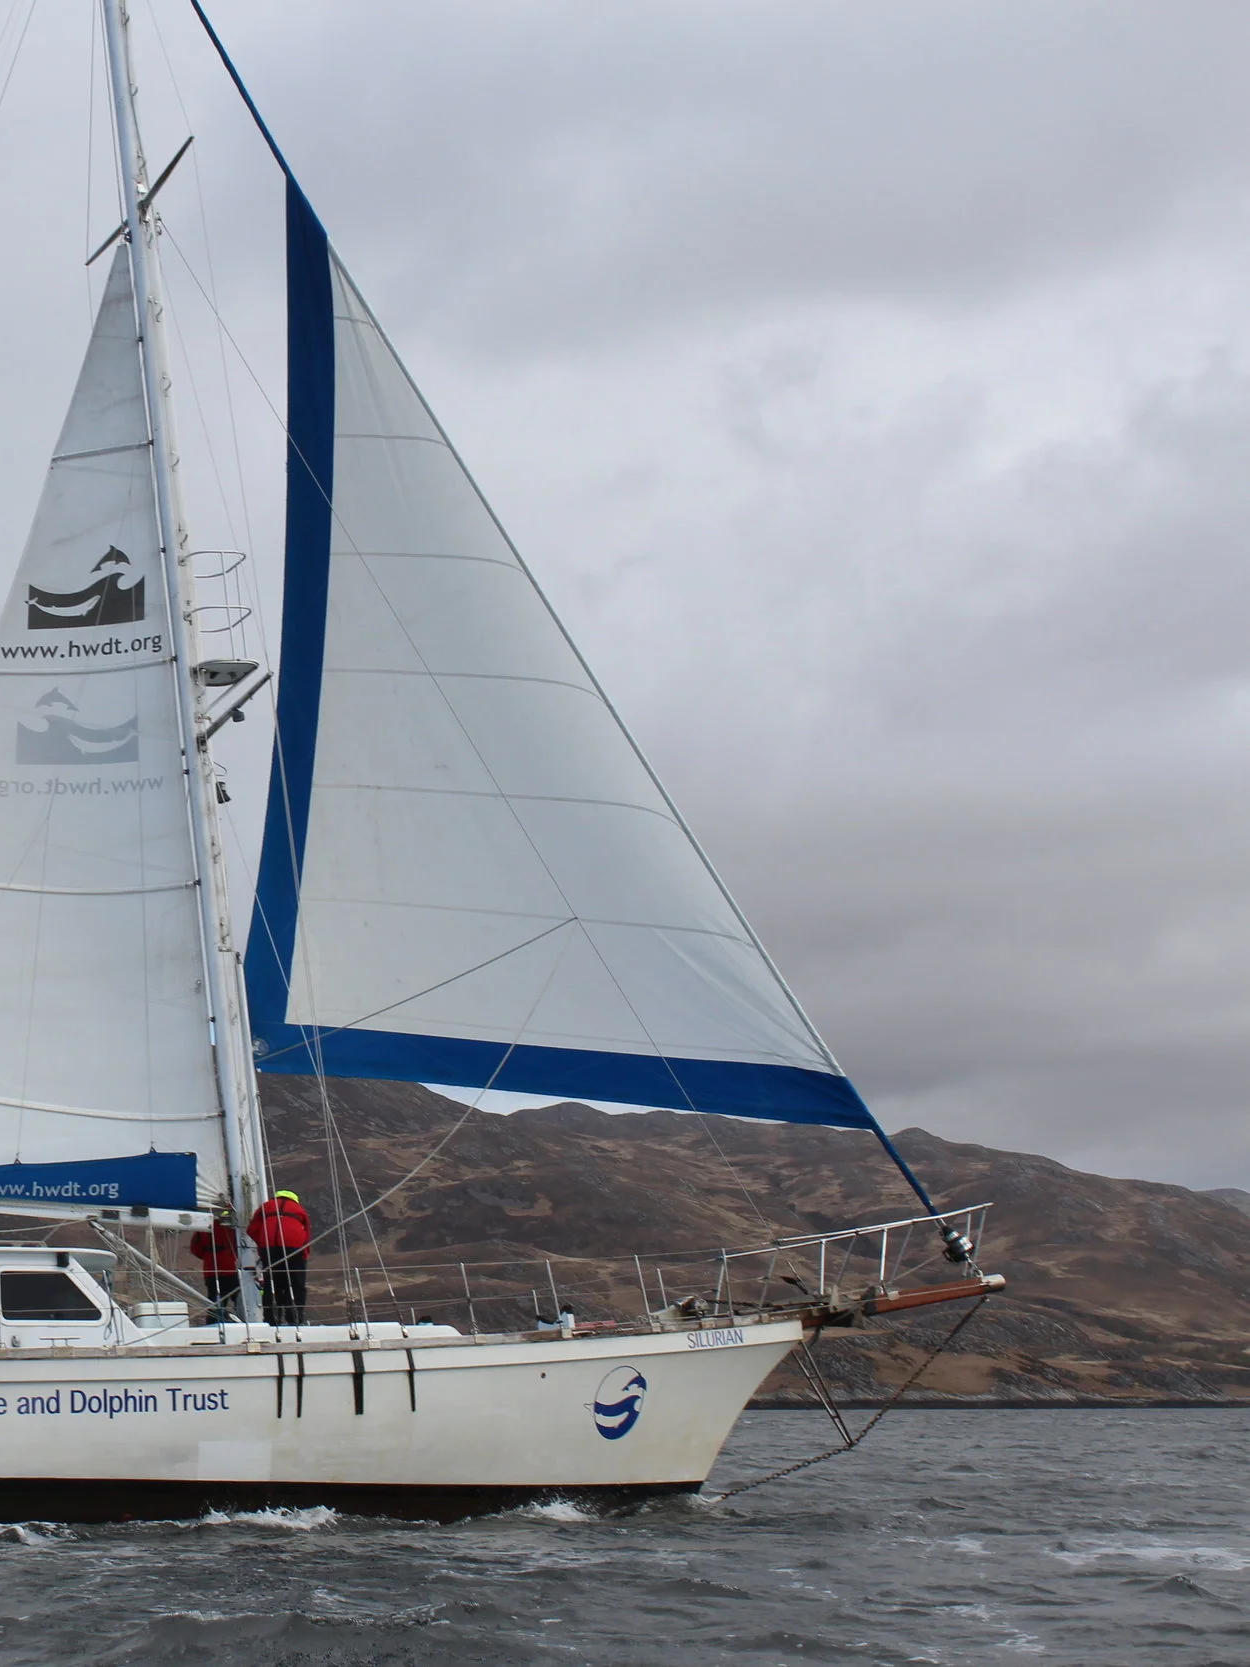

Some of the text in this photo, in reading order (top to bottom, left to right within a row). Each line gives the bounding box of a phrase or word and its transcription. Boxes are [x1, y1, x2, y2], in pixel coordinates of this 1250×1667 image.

[1, 634, 162, 659] www.hwdt.org
[687, 1329, 744, 1348] SILURIAN
[16, 1389, 61, 1415] and
[70, 1388, 158, 1419] Dolphin
[165, 1388, 230, 1412] Trust
